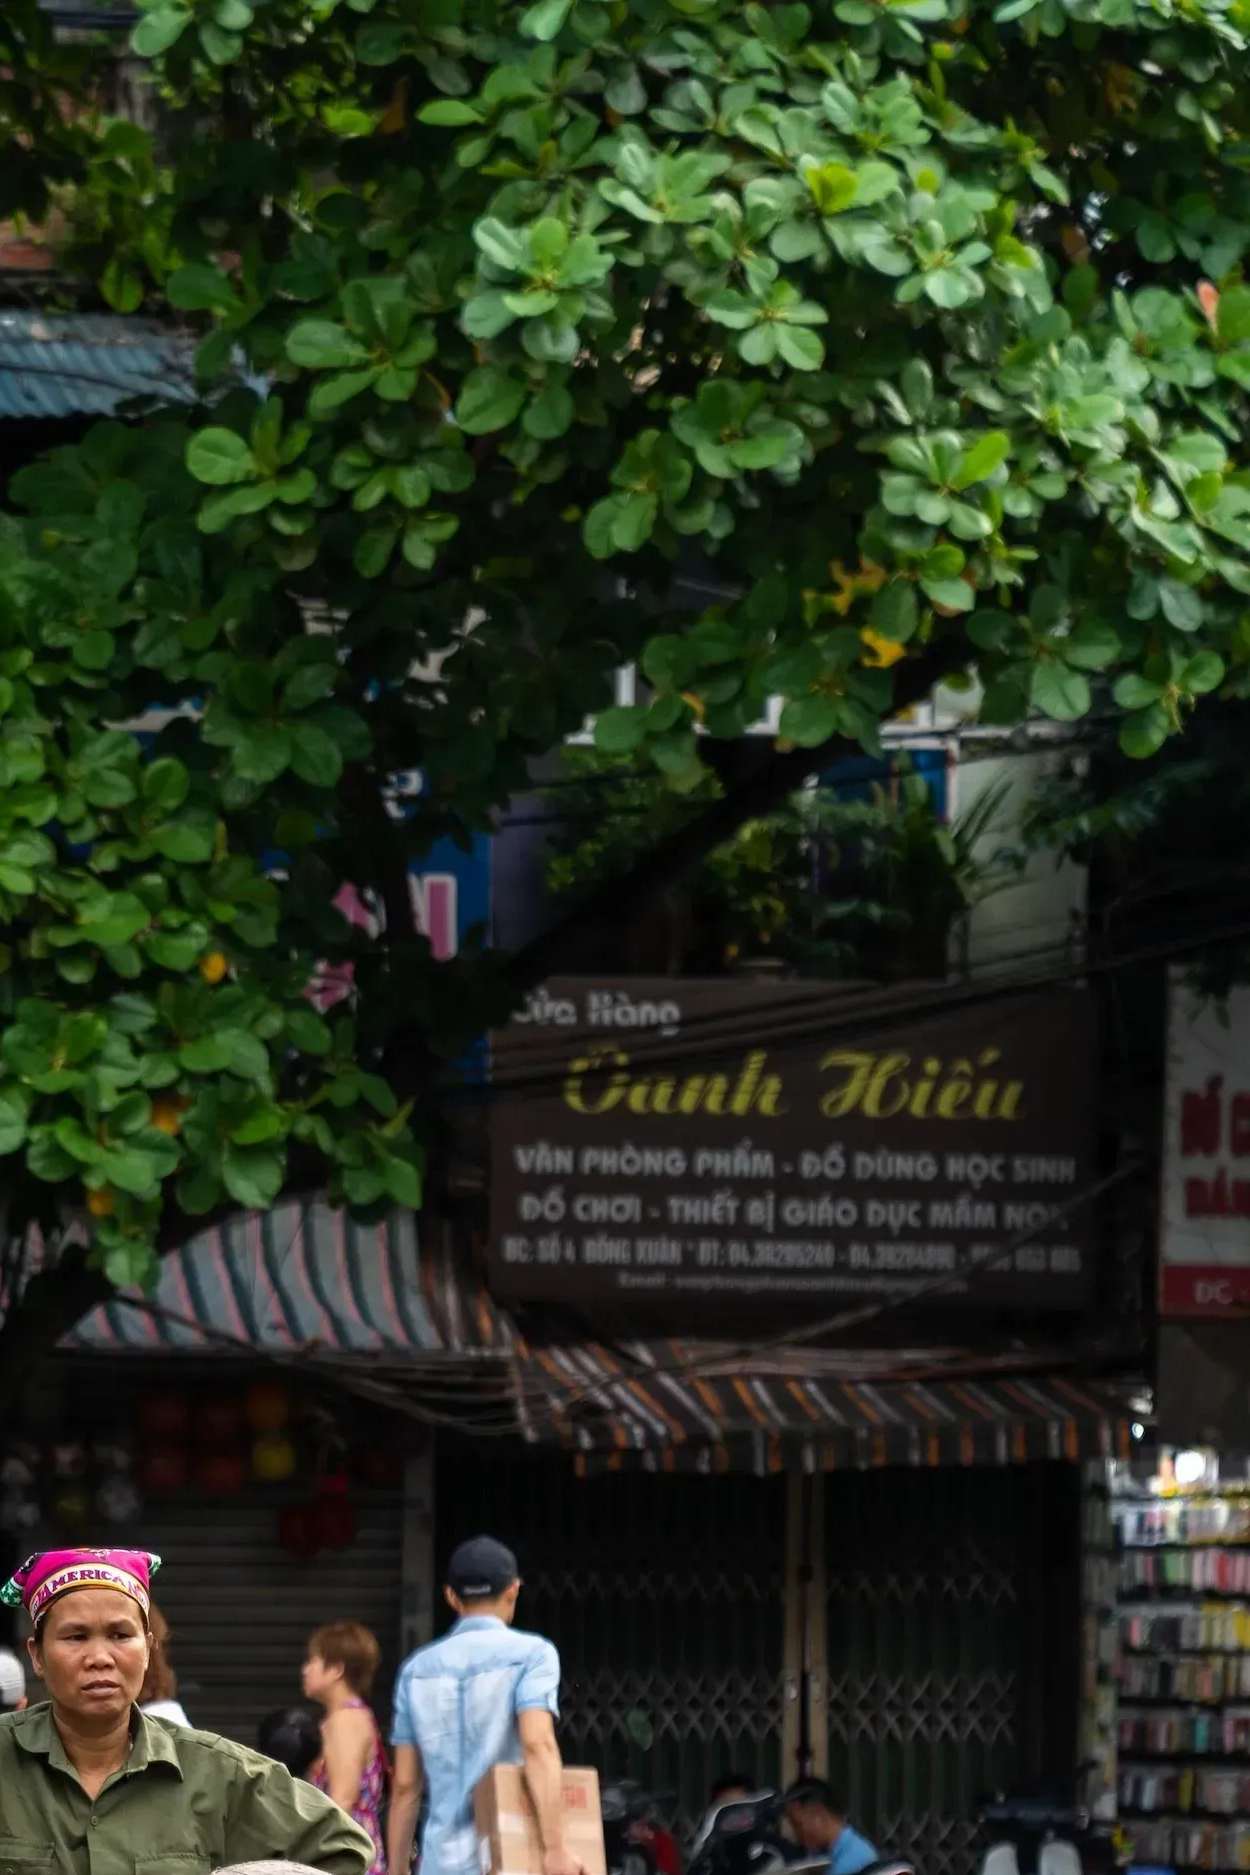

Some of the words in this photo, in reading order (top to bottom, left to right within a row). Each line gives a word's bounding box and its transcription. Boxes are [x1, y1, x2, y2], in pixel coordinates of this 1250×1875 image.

[586, 989, 681, 1036] Hàng
[816, 1046, 1025, 1121] Hiếu
[579, 1139, 688, 1179] PHÒNG
[693, 1136, 775, 1179] PHẨM
[852, 1145, 939, 1182] DÙNG
[945, 1151, 1006, 1191] HỌC
[1012, 1154, 1076, 1184] SINH
[571, 1193, 642, 1224] CHƠI
[667, 1185, 740, 1226] THIẾT
[744, 1189, 775, 1234] BỊ
[780, 1190, 858, 1228] GIÁO
[864, 1197, 922, 1238] DỤC
